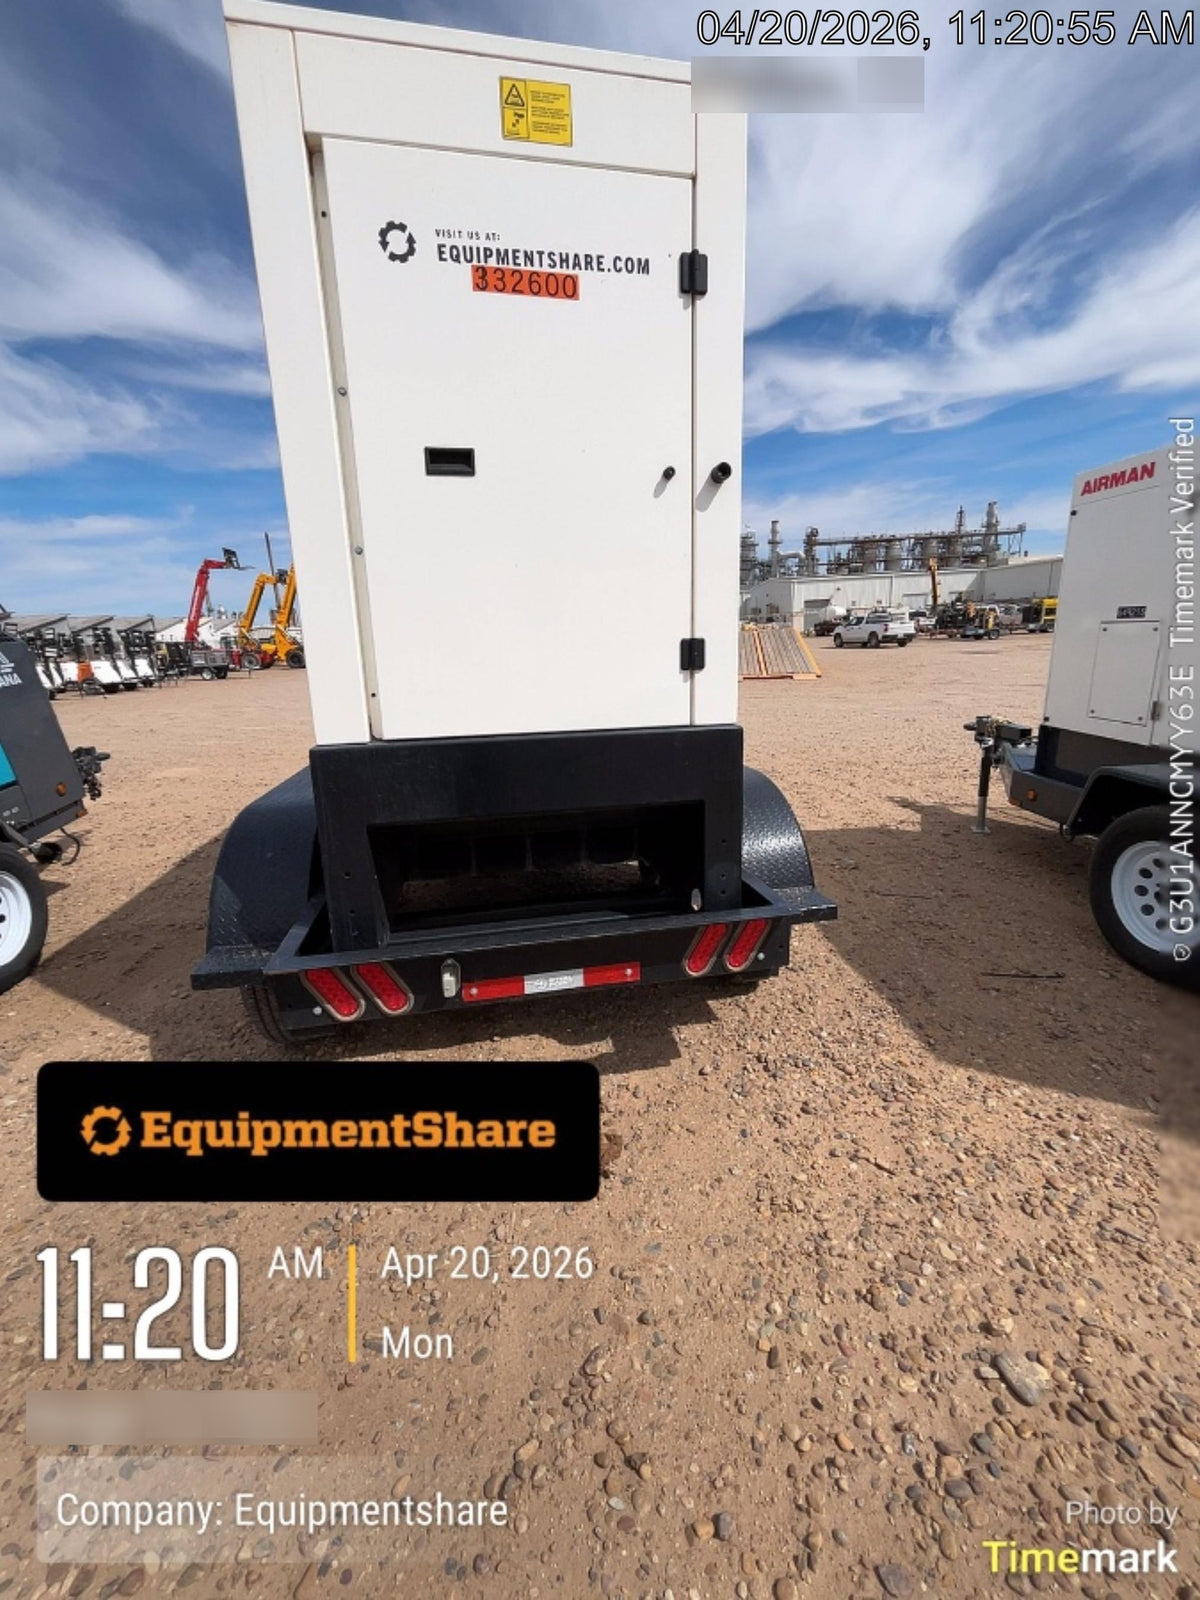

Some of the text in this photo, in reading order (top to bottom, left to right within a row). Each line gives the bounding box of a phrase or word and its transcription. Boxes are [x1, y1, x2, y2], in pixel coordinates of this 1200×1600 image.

[435, 228, 501, 241] VISIT US AT:
[437, 243, 650, 275] EQUIPMENTSHARE.COM
[475, 265, 577, 298] 332600
[1081, 462, 1156, 496] AIRMAN
